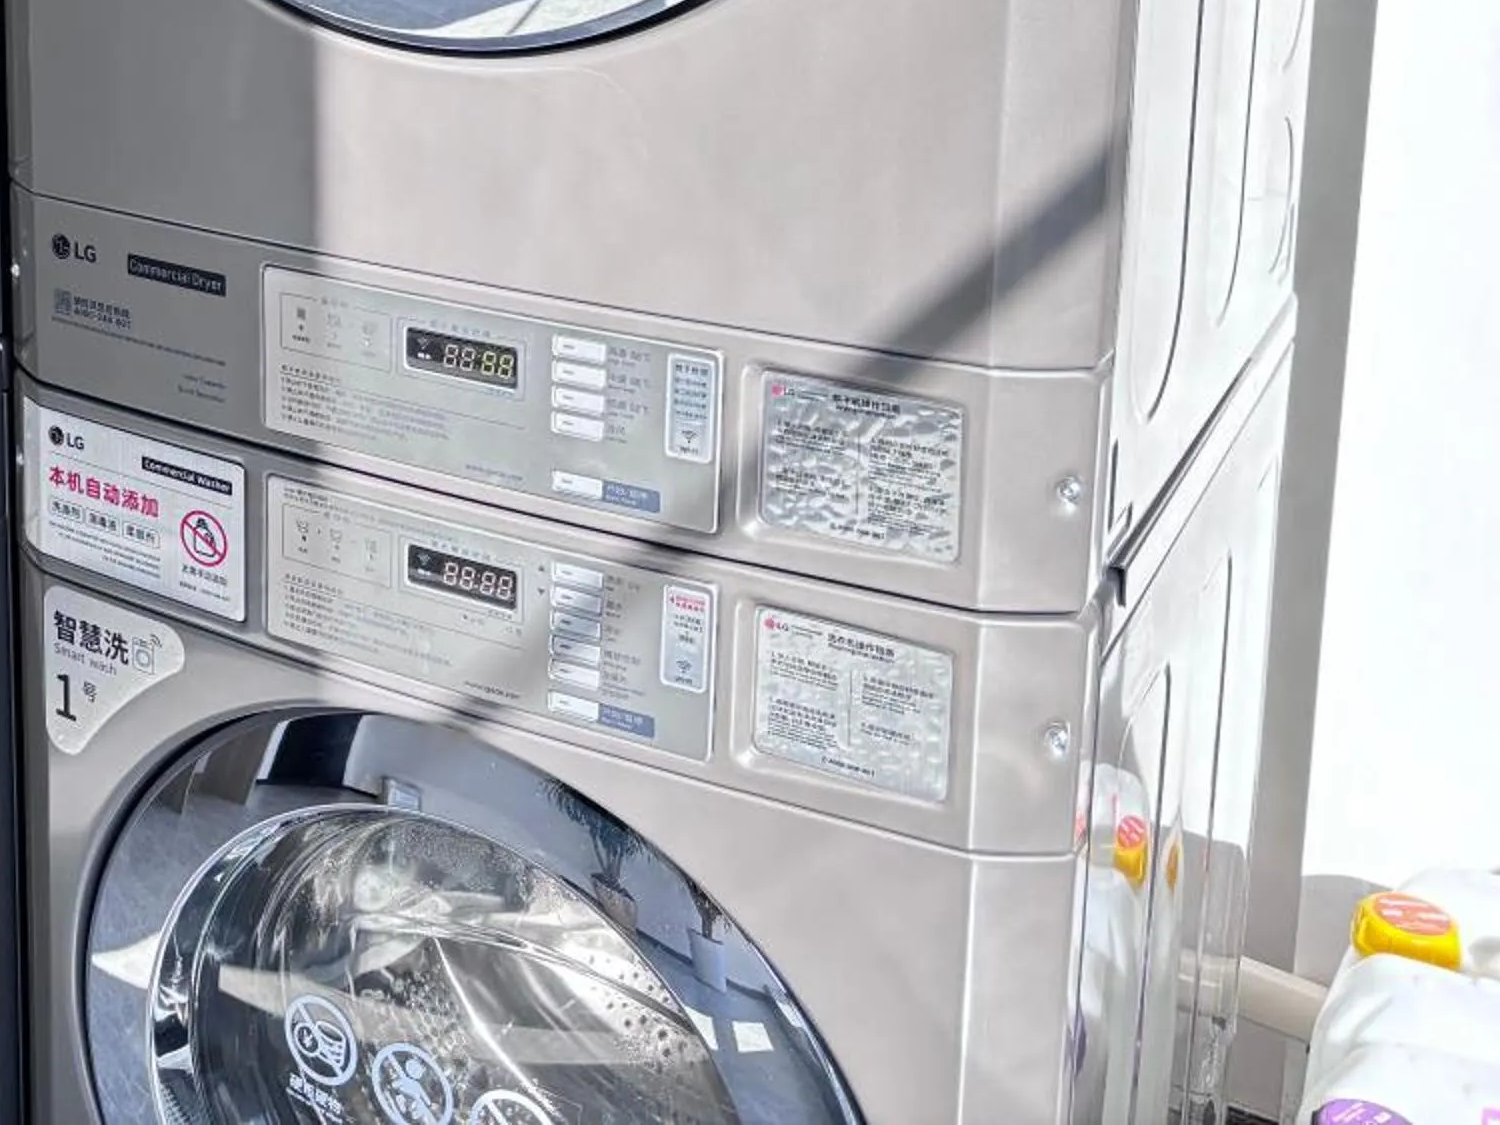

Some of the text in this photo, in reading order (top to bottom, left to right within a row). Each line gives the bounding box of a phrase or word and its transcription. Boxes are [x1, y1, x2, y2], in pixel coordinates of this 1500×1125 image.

[192, 274, 223, 292] Dryer
[49, 465, 160, 518] 本机自动添加
[197, 473, 231, 494] Washer
[53, 610, 129, 665] 智慧洗
[54, 642, 85, 666] Smart
